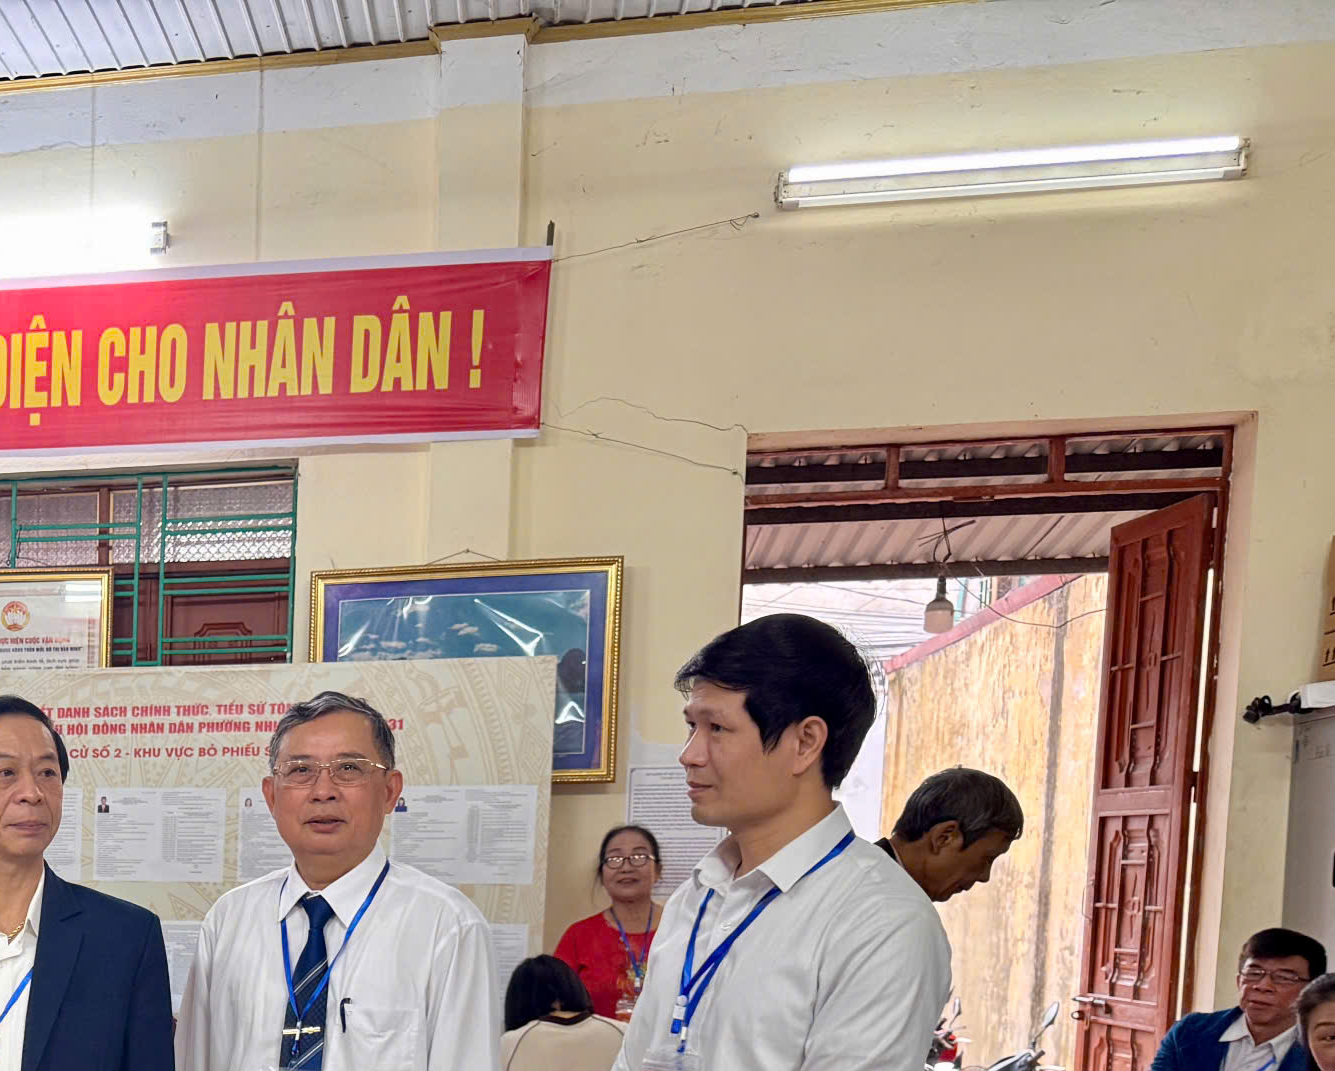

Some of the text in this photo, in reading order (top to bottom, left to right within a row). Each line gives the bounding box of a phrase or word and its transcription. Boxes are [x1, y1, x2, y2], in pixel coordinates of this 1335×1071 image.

[97, 323, 188, 406] CHO
[202, 301, 336, 400] NHÂN
[350, 295, 452, 393] DÂN
[468, 309, 485, 389] !
[57, 706, 91, 718] DANH
[94, 704, 127, 718] SÁCH
[131, 704, 171, 717] CHÍNH
[216, 702, 244, 715] TIỂU
[248, 702, 268, 714] SỬ
[67, 722, 89, 737] HỘI
[91, 721, 127, 735] ĐỒNG
[130, 722, 165, 735] NHÂN
[168, 721, 194, 734] DÂN
[198, 720, 251, 734] PHƯỜNG
[69, 744, 90, 759] CỬ
[92, 744, 111, 759] SỐ
[114, 748, 122, 758] 2
[134, 747, 161, 758] KHU
[165, 746, 194, 760] VỰC
[198, 744, 218, 757] BỎ
[221, 742, 260, 757] PHIẾU
